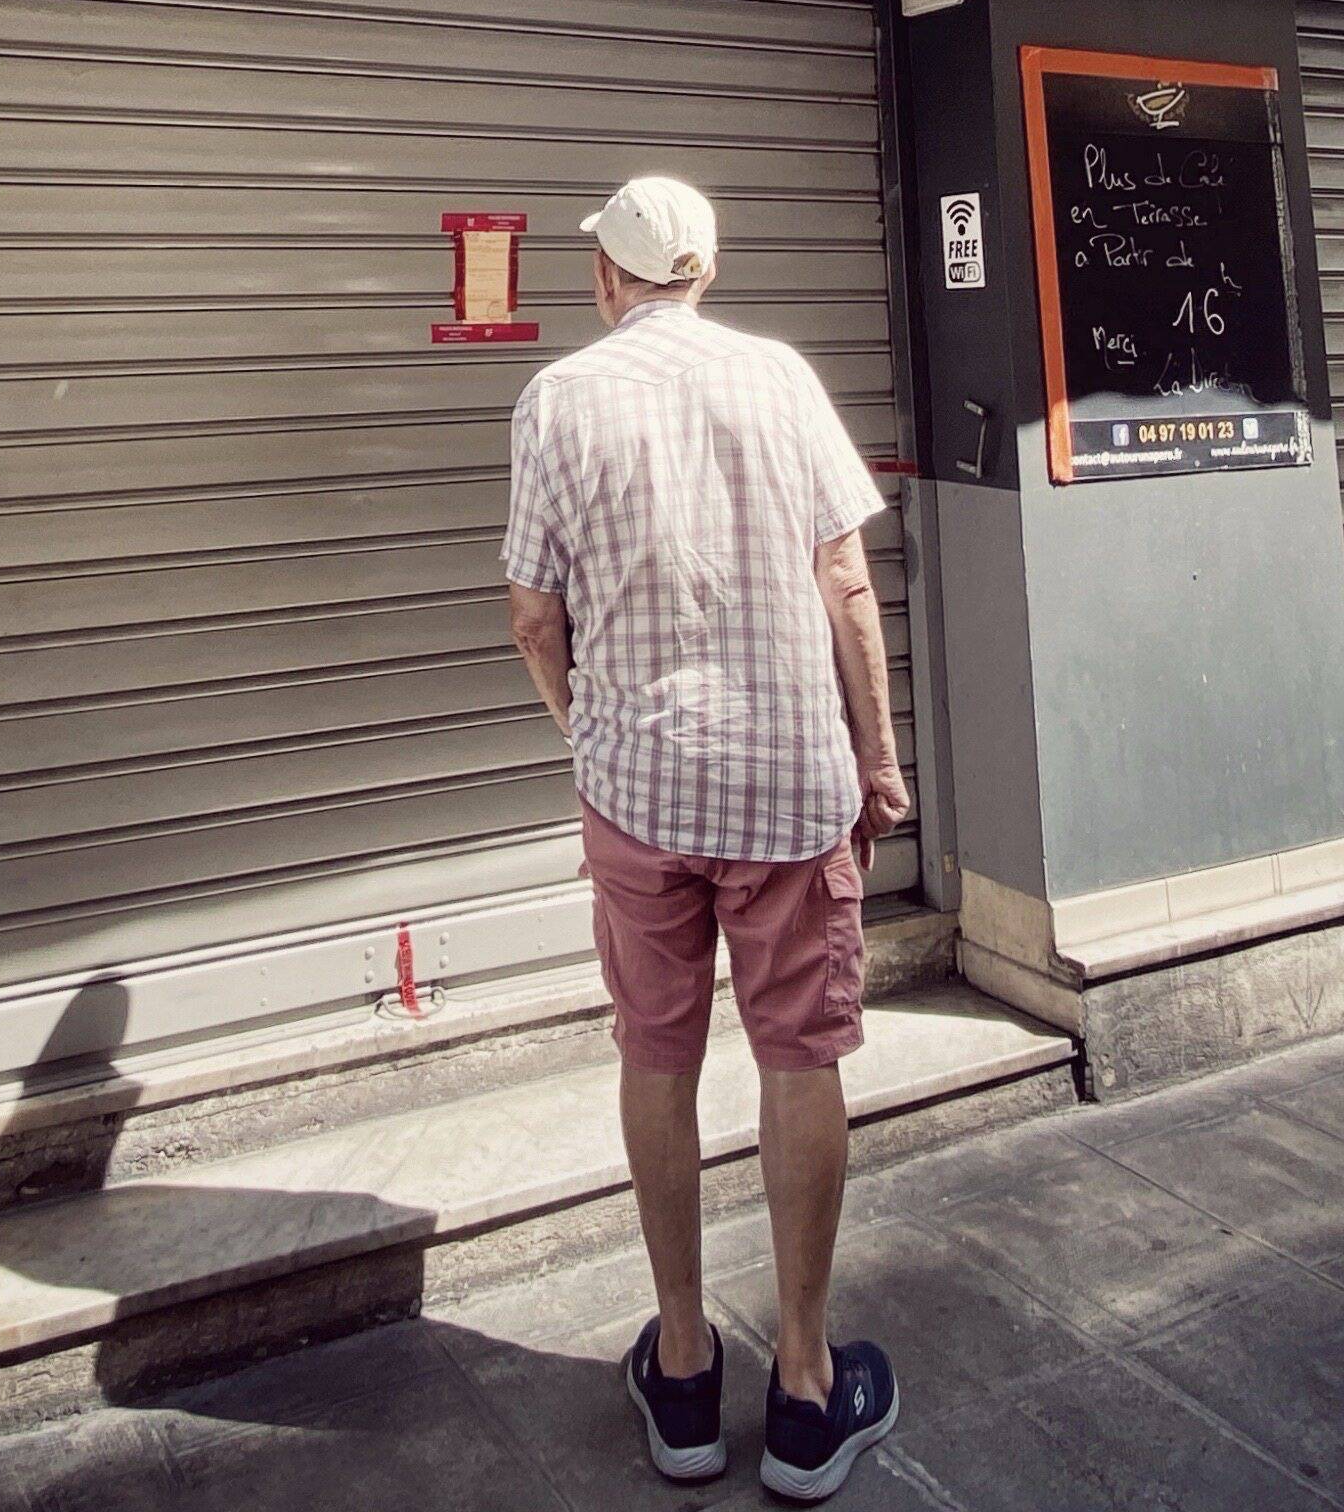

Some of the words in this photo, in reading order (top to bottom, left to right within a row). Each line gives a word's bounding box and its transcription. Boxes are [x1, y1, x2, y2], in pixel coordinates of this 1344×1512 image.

[1084, 143, 1136, 191] Plus
[1144, 153, 1172, 185] de
[1071, 206, 1107, 228] en
[949, 239, 978, 259] FREE
[1166, 240, 1194, 267] de
[1092, 326, 1138, 370] Merci
[1139, 425, 1156, 443] 04
[1159, 424, 1176, 442] 97
[1180, 423, 1196, 440] 19
[1198, 422, 1214, 440] 01
[1218, 421, 1235, 439] 23
